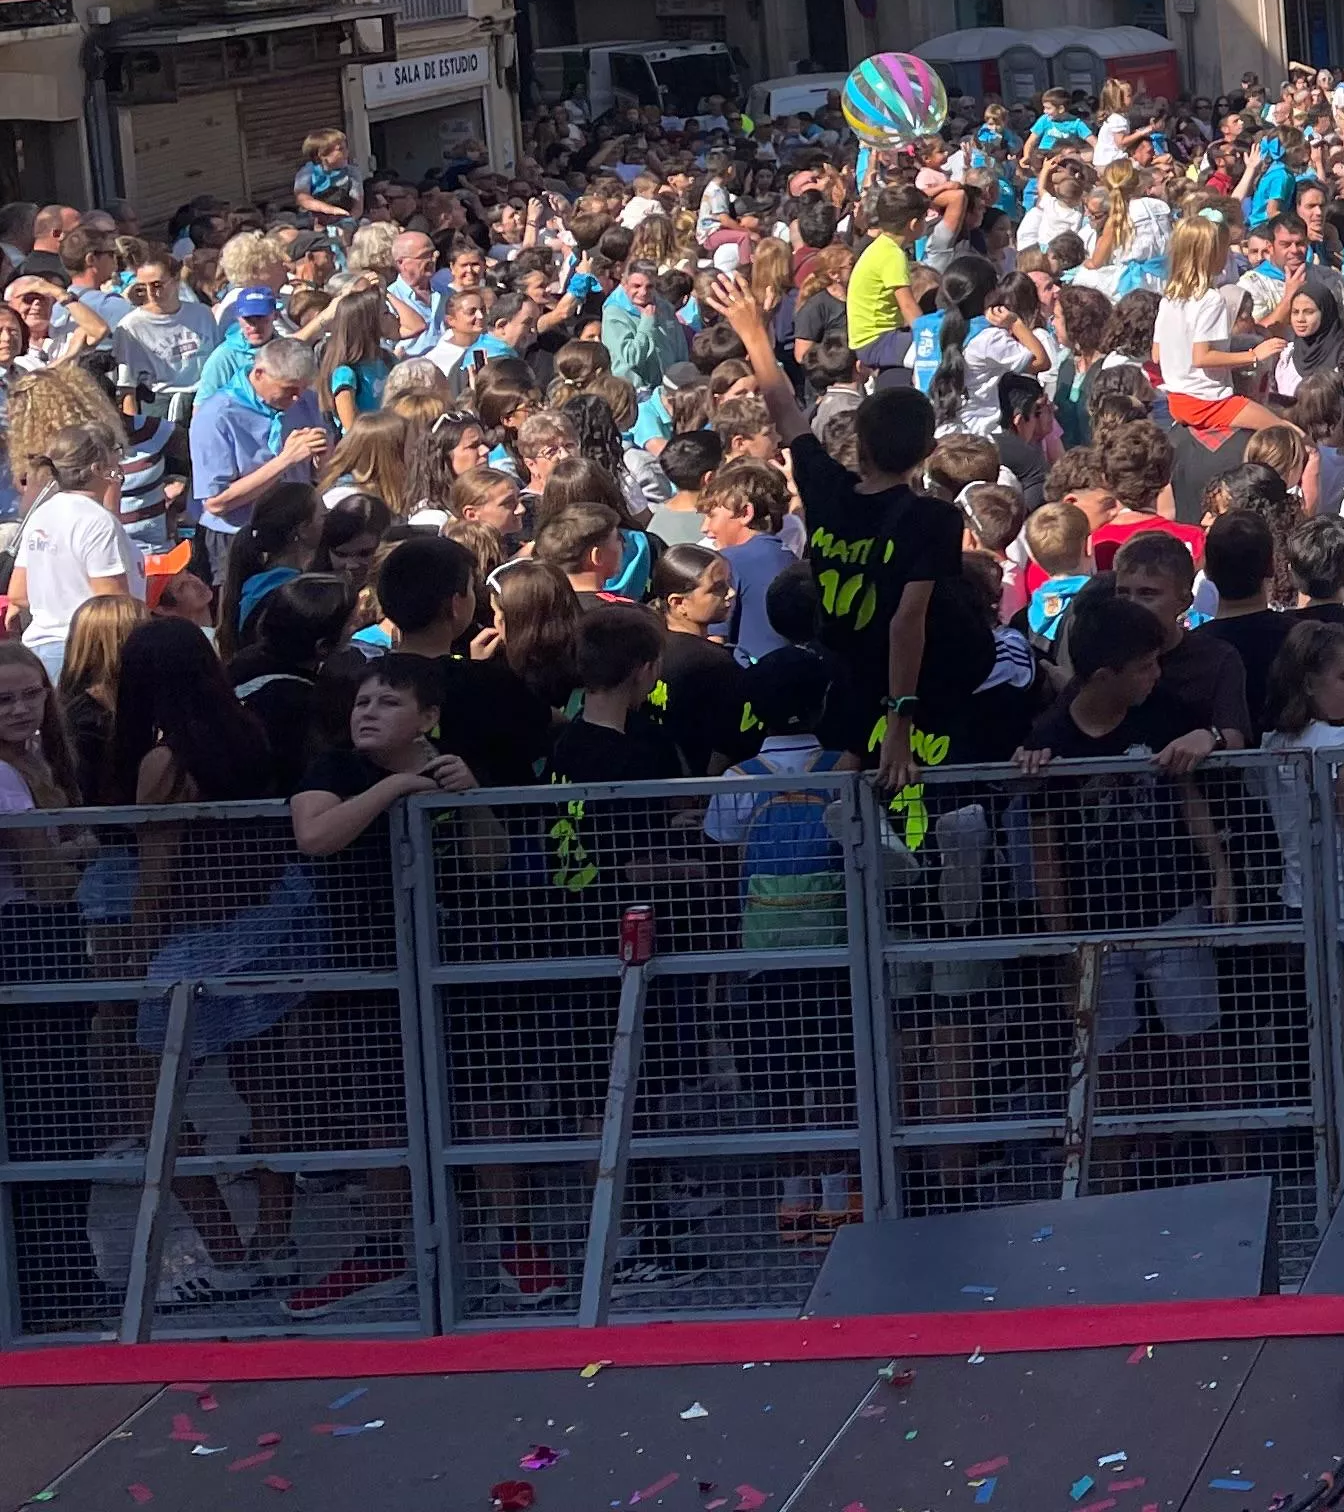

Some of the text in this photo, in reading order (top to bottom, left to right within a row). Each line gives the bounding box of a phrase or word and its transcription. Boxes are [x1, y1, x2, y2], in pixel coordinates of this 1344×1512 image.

[394, 54, 478, 85] SALA DE ESTUDIO
